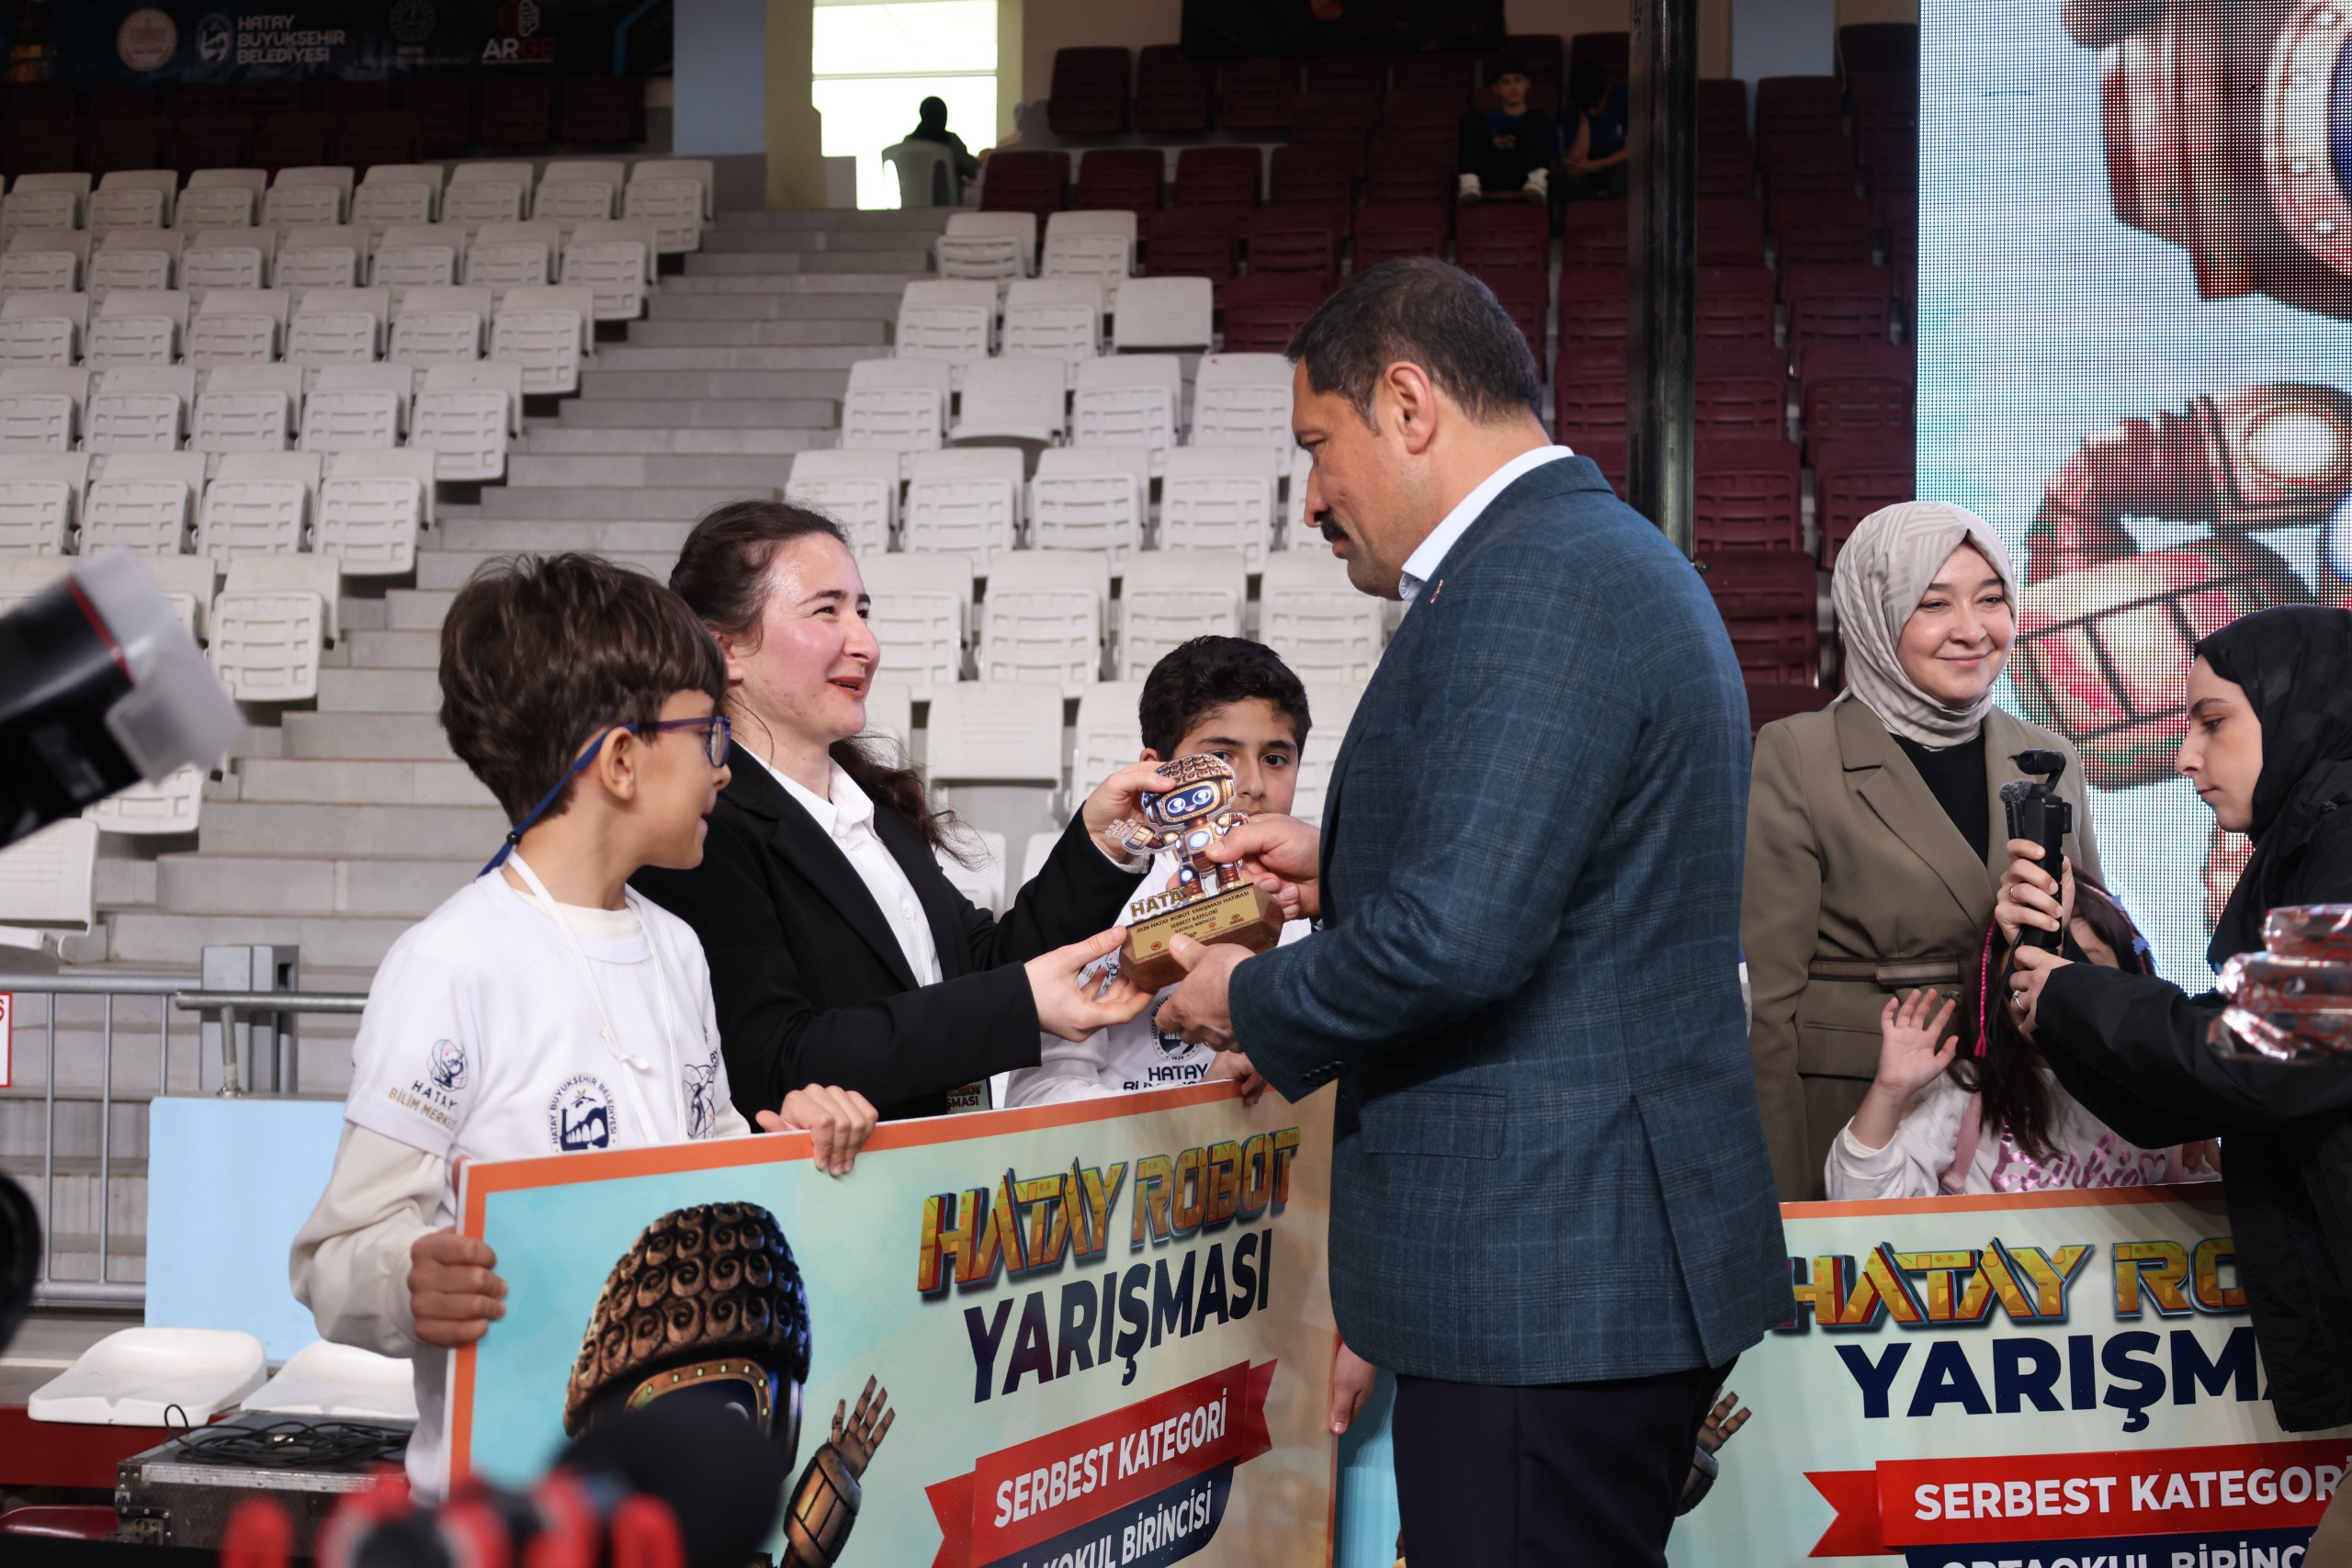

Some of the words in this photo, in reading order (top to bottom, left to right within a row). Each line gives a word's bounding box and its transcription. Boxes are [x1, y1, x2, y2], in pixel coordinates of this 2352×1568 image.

[238, 15, 295, 31] HATAY
[481, 36, 556, 59] ARGE
[1130, 883, 1193, 918] HATAY
[1150, 919, 1169, 928] HATAY
[1170, 911, 1190, 921] ROBOT
[1170, 918, 1191, 929] SERBEST
[1148, 1063, 1208, 1081] HATAY
[412, 1079, 458, 1110] HATAY
[549, 1114, 559, 1144] HATAY
[918, 1156, 1128, 1293] HATAY
[1131, 1126, 1301, 1247] ROBOT
[963, 1228, 1272, 1404] YARIŞMASI
[1834, 1326, 2274, 1433] YARIŞM
[993, 1445, 1114, 1528] SERBEST
[1118, 1387, 1228, 1481] KATEGORİ
[1915, 1476, 2117, 1521] SERBEST
[2131, 1455, 2352, 1512] KATEGOR
[1122, 1481, 1212, 1566] BİRİNCİSİ
